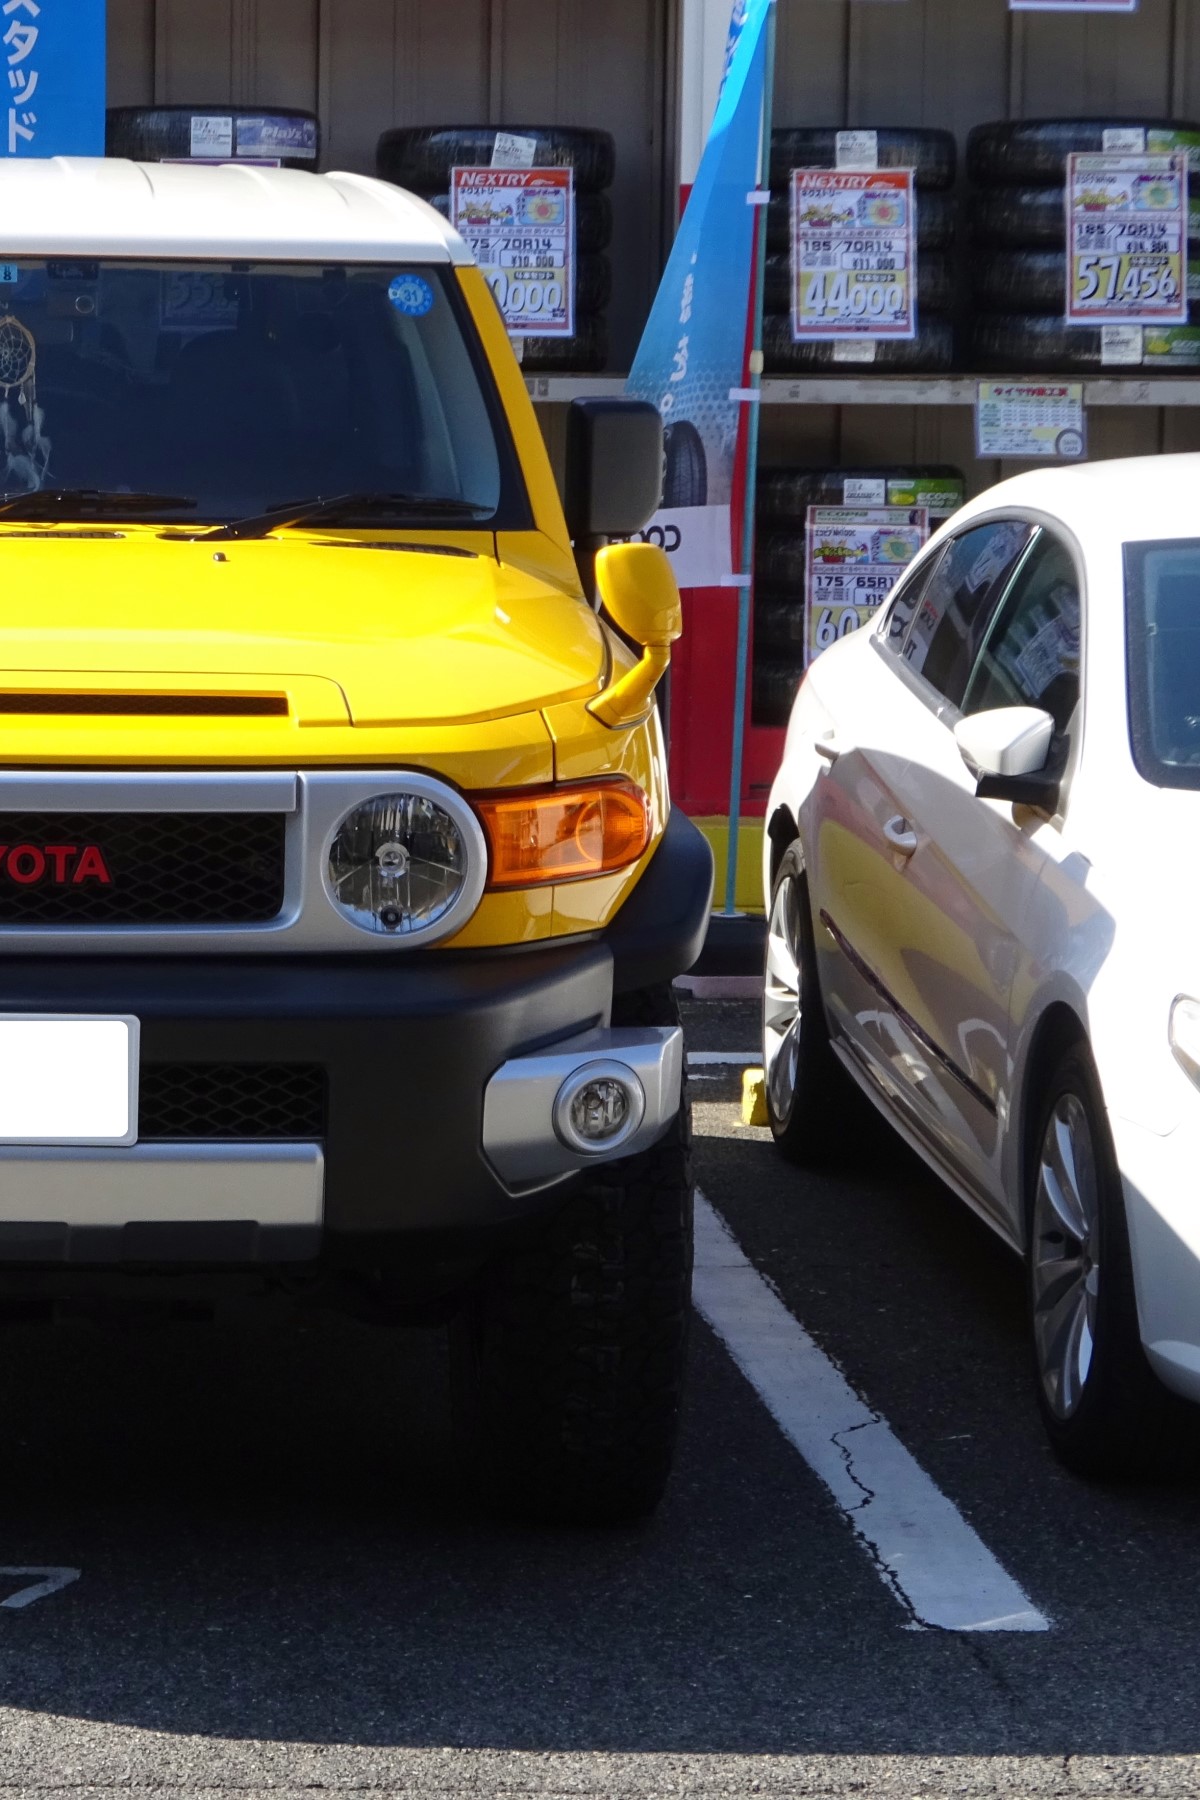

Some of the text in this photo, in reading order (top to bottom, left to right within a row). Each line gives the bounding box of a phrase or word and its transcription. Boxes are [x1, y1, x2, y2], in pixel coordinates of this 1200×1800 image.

[460, 172, 531, 186] NEXTRY
[801, 175, 872, 188] NEXTRY
[1078, 223, 1167, 236] 185/70R14
[466, 238, 552, 249] 75/70R14
[803, 240, 893, 252] 185/70R14
[1079, 256, 1177, 301] 57,456
[403, 289, 418, 302] 31
[486, 270, 562, 315] 0,000
[805, 271, 903, 317] 44,000
[816, 576, 896, 587] 175/65R1
[865, 594, 884, 605] ¥15
[816, 607, 861, 650] 60
